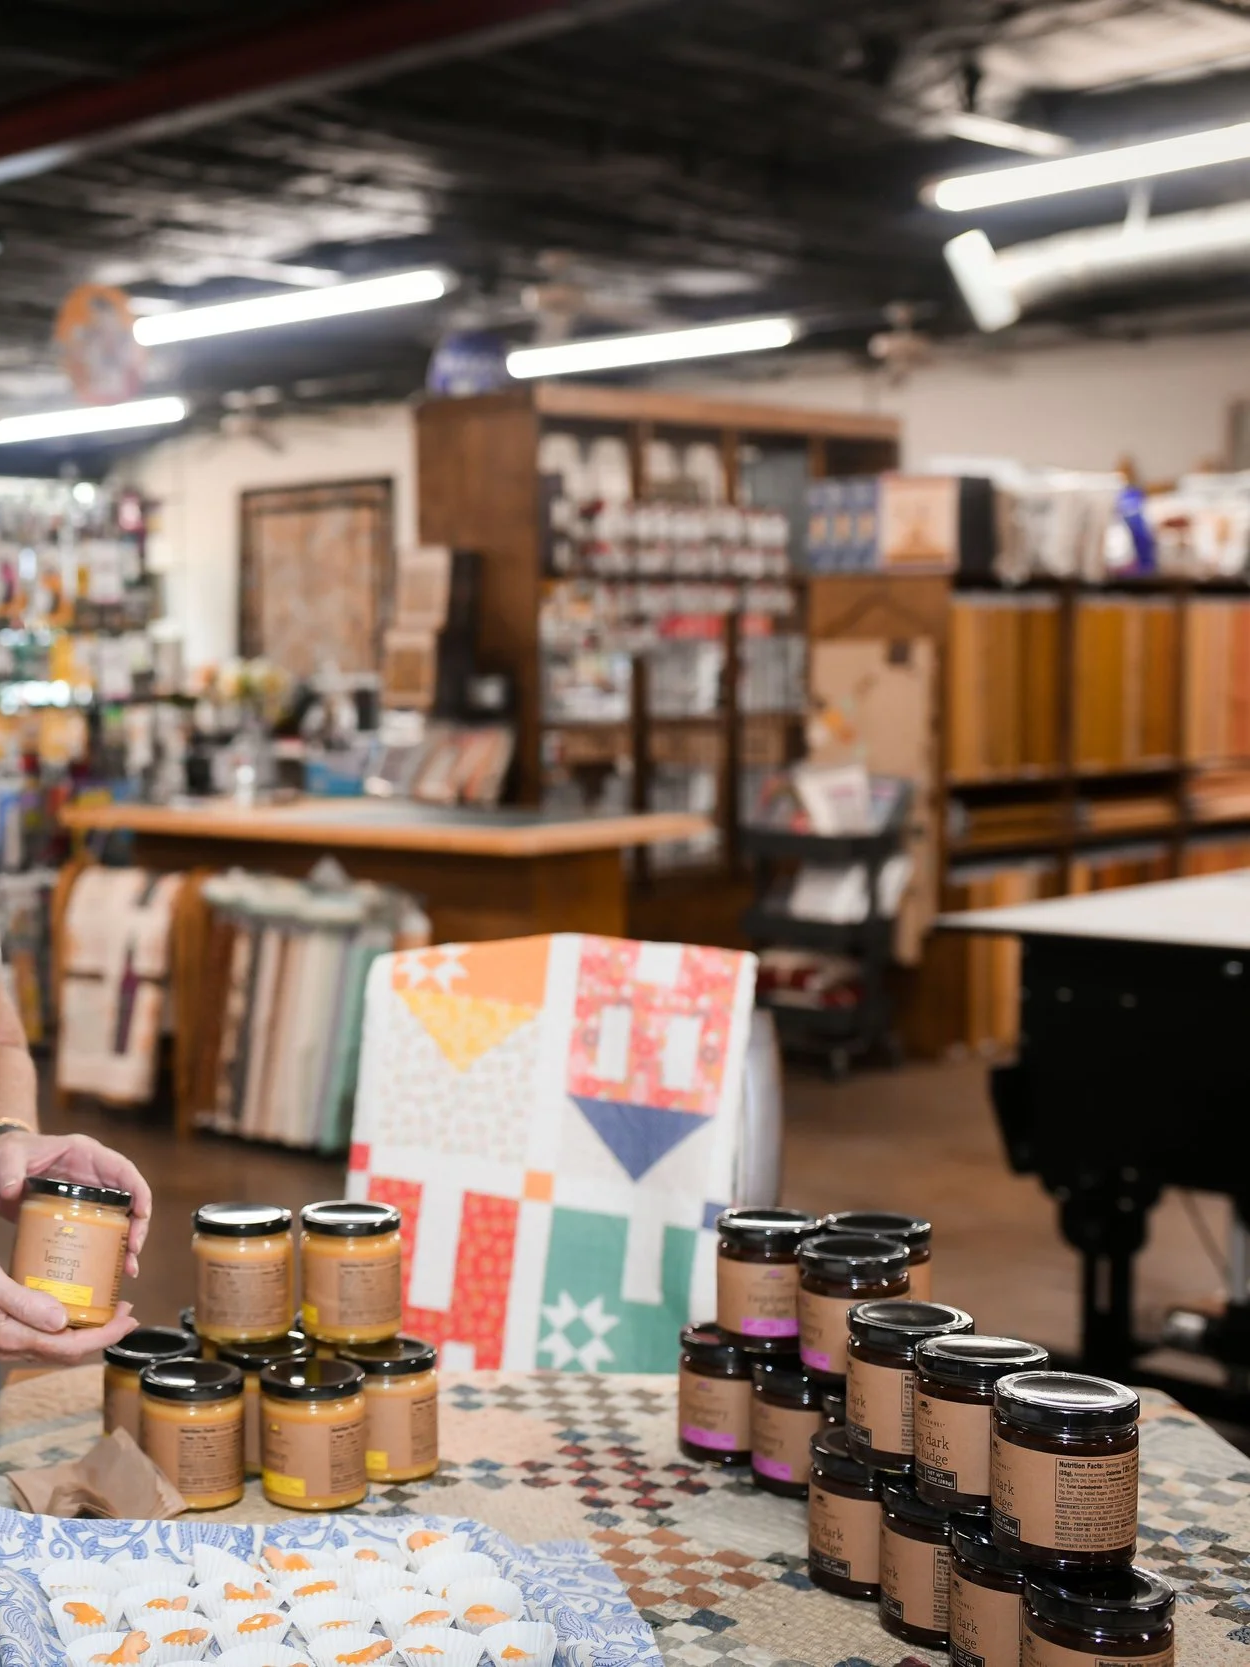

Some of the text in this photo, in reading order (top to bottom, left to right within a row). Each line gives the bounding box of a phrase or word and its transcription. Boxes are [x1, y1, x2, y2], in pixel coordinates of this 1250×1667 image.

[44, 1249, 80, 1268] lemon
[46, 1268, 75, 1281] curd
[925, 1431, 950, 1451] dark
[996, 1474, 1015, 1495] dark
[957, 1612, 978, 1635] dark
